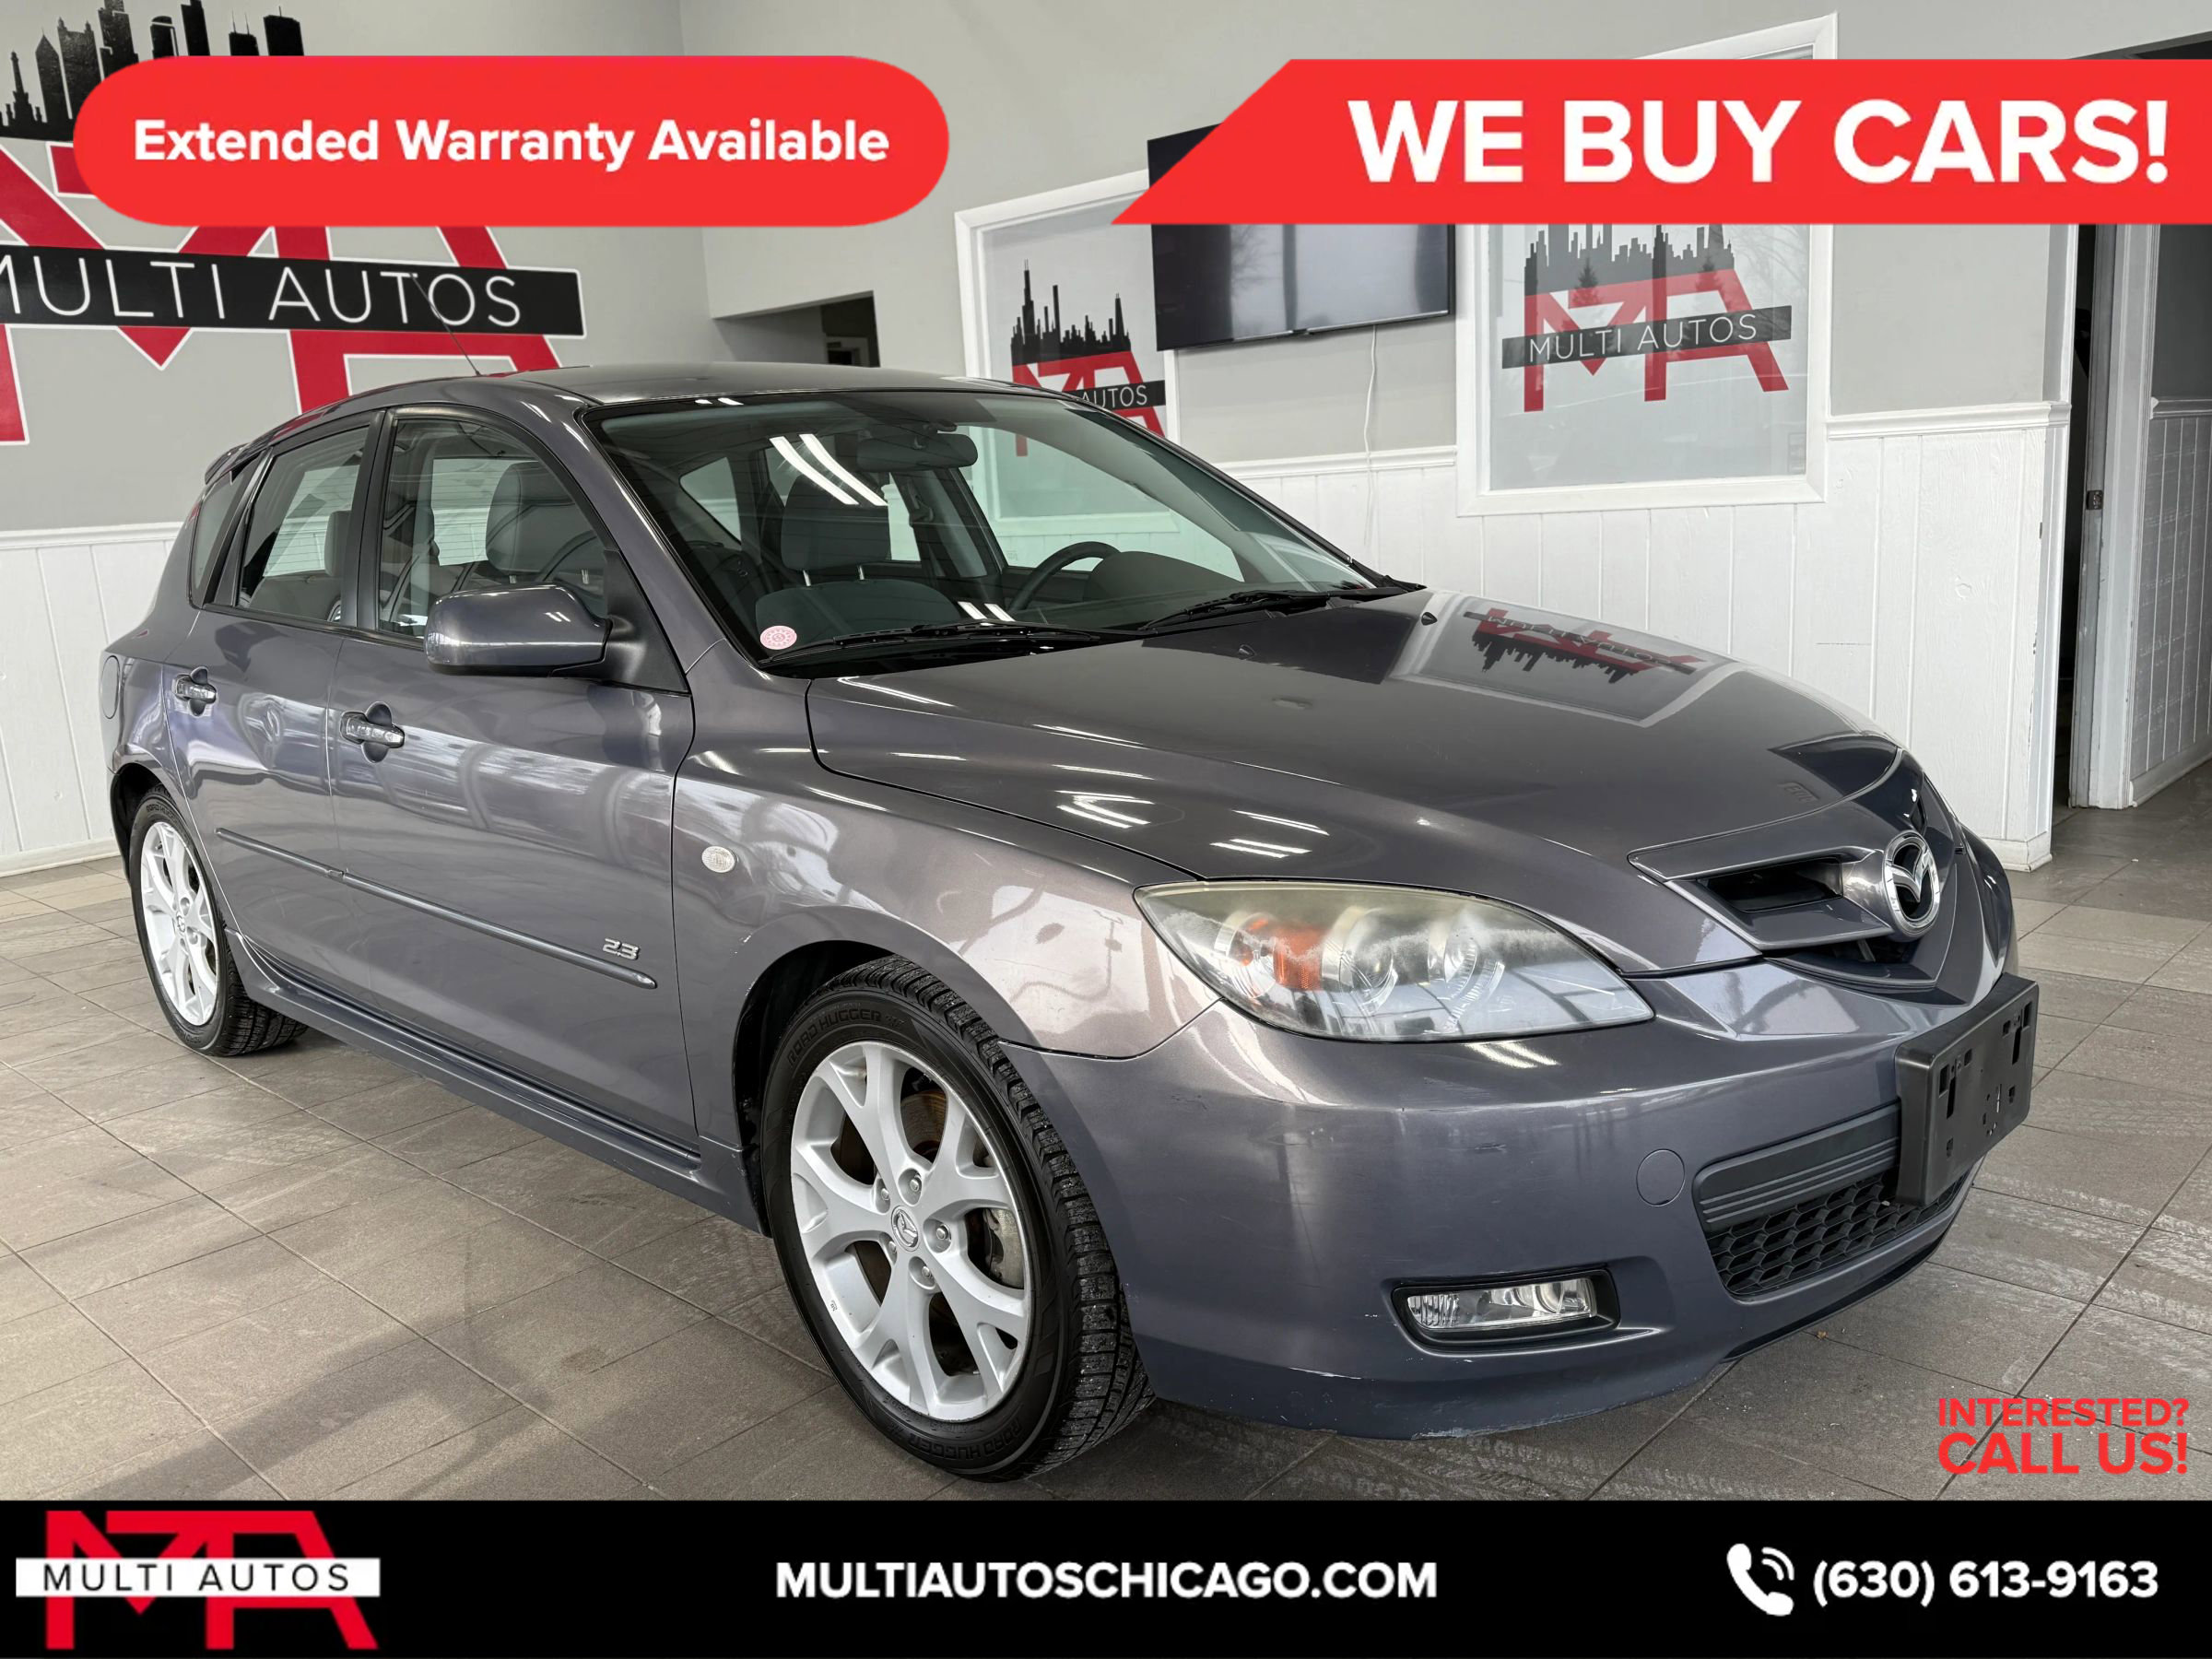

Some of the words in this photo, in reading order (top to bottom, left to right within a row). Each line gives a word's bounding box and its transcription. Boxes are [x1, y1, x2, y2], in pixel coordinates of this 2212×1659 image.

[268, 265, 522, 327] AUTOS
[1529, 327, 1621, 362] MULTI
[1637, 313, 1758, 350] AUTOS
[786, 1023, 818, 1066] ROAD
[818, 1007, 882, 1031] HUGGER
